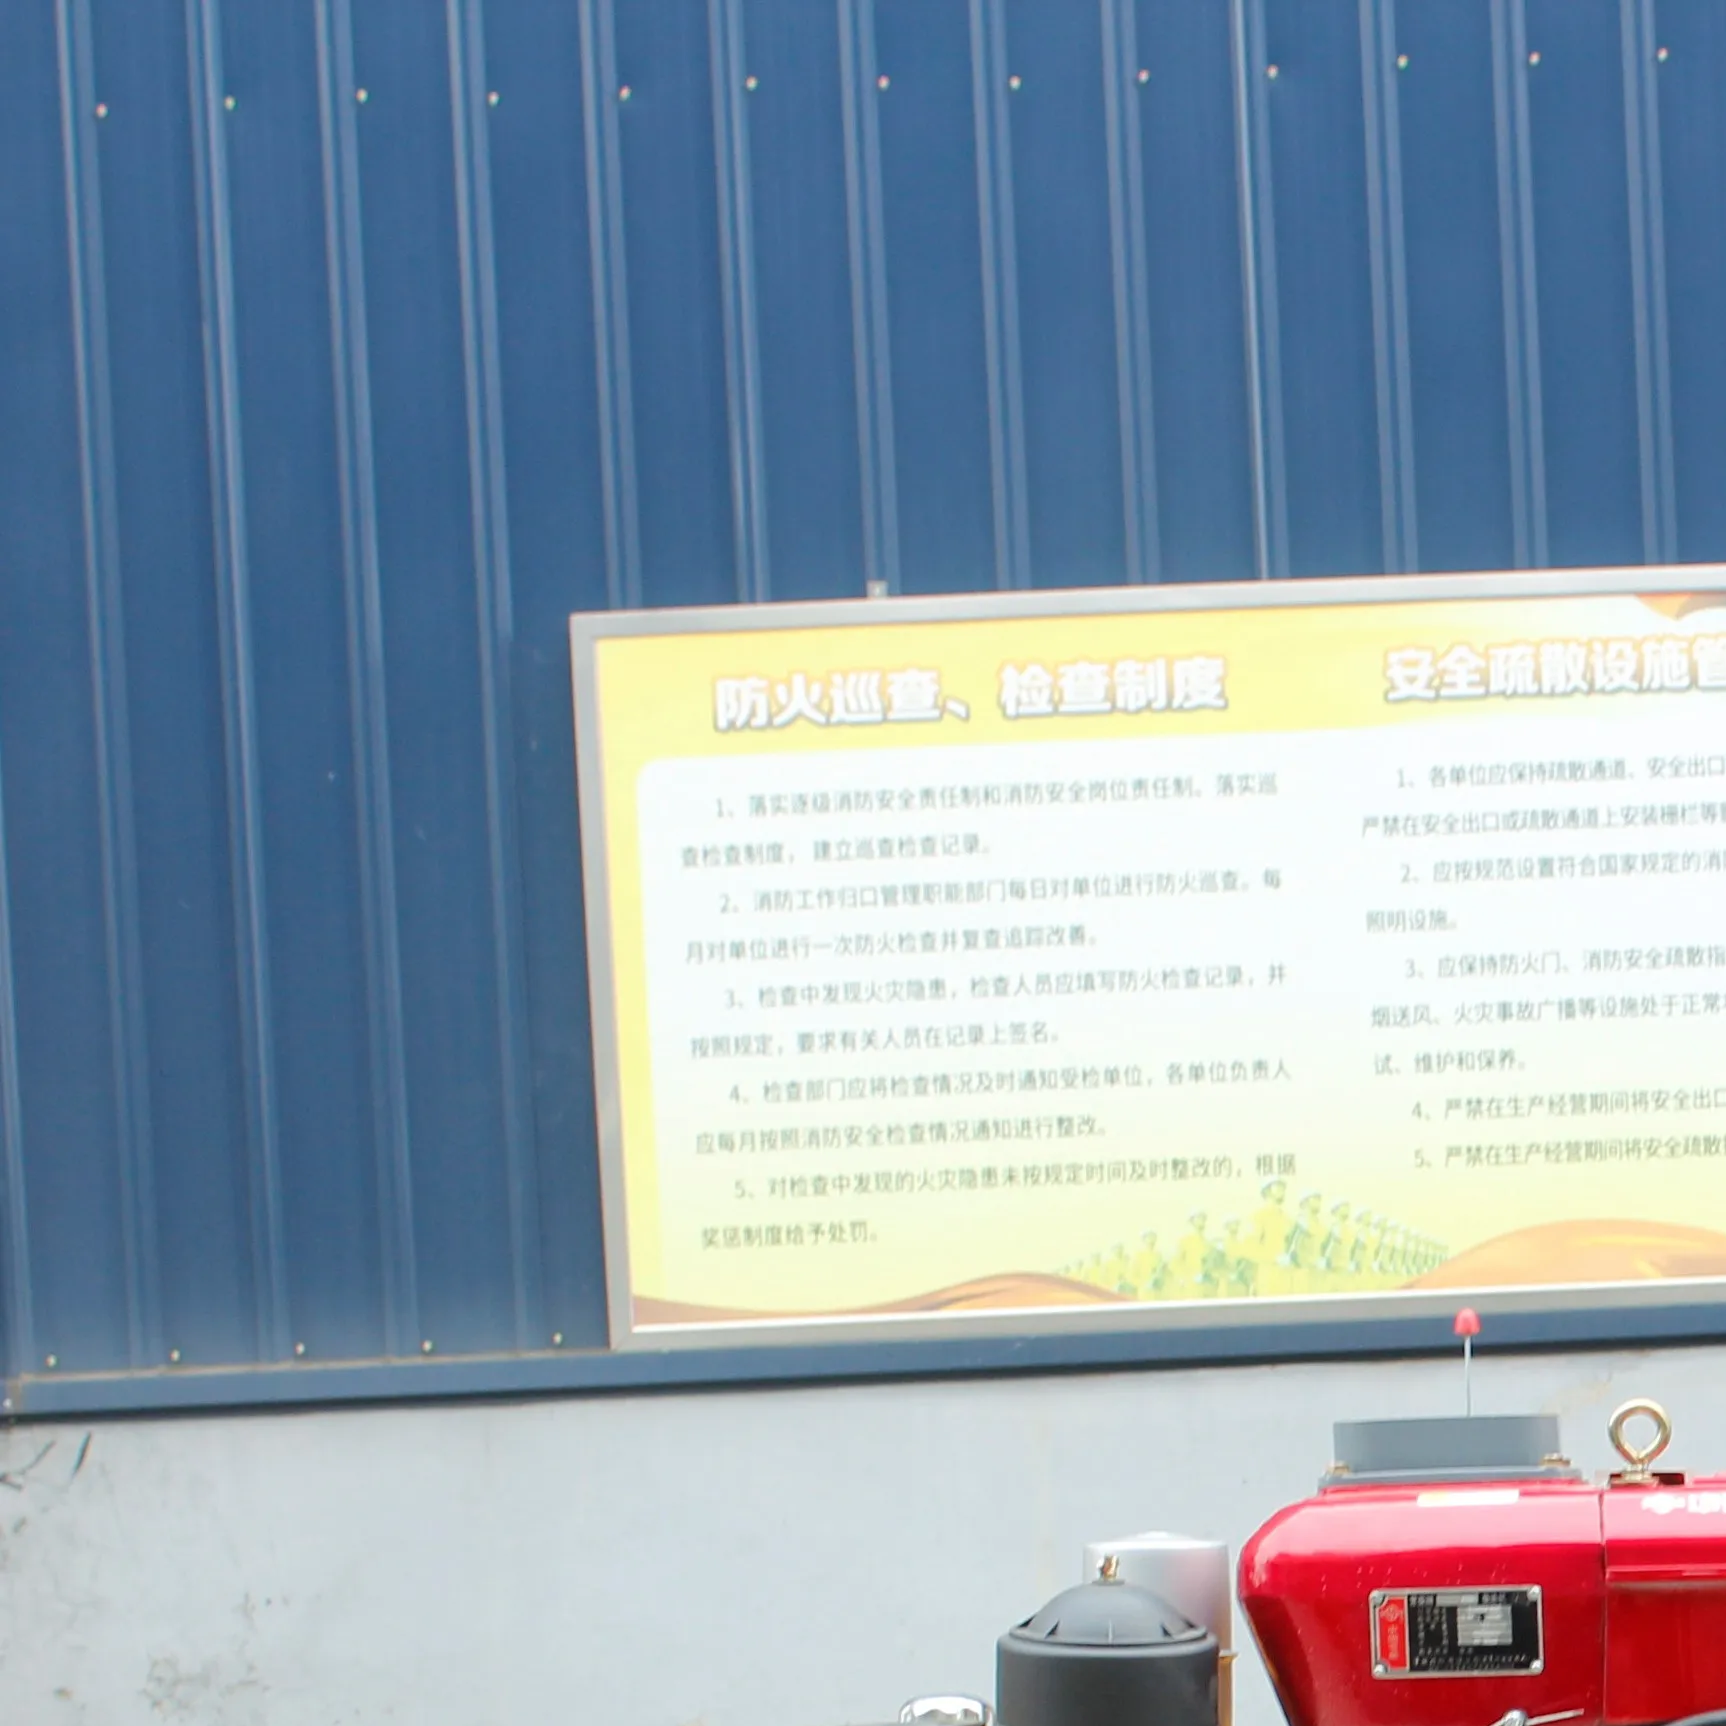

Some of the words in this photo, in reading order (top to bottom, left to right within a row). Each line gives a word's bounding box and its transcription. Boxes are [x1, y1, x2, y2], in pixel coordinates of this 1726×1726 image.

[713, 657, 1229, 732] 防火巡查、检查制度
[1365, 906, 1457, 934] 照明设施。
